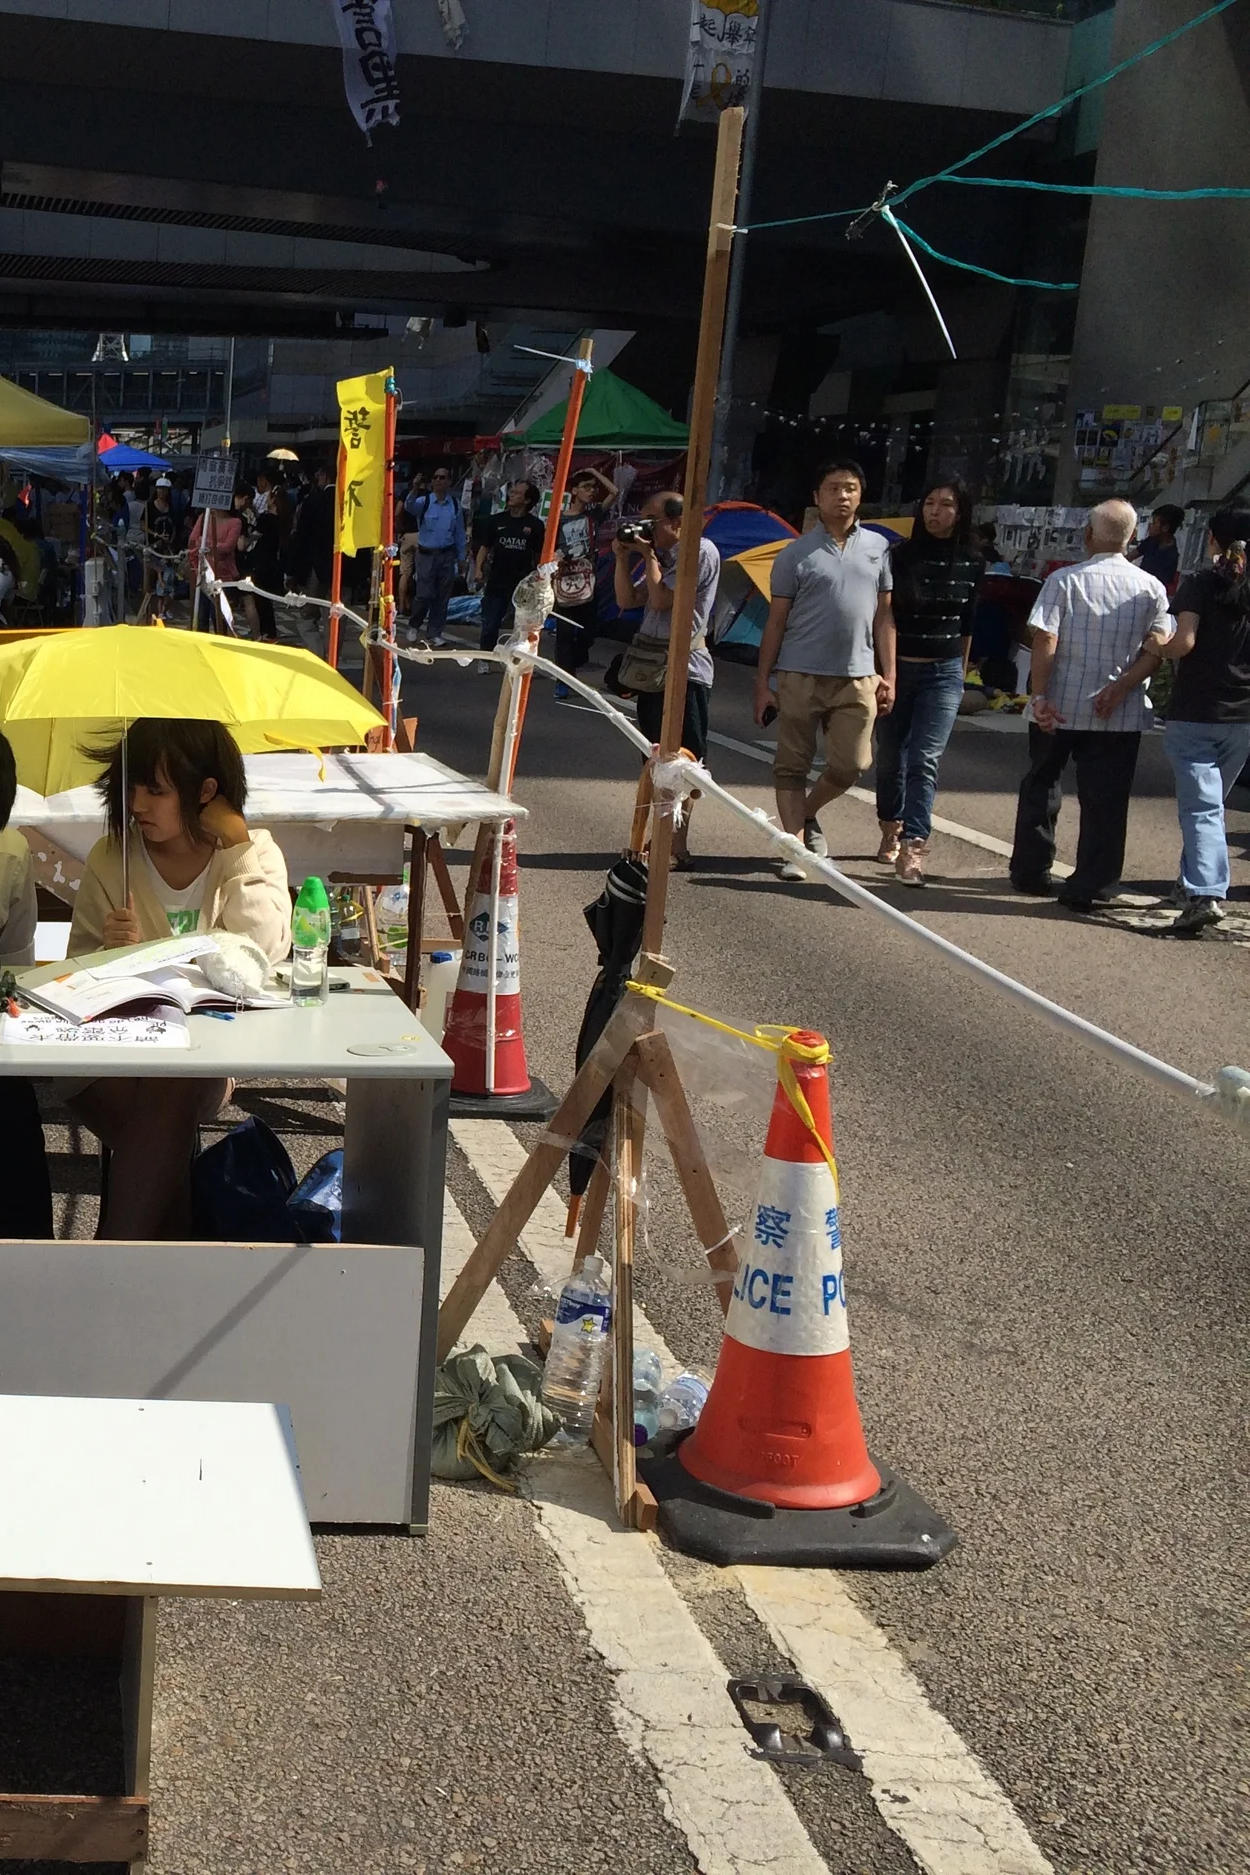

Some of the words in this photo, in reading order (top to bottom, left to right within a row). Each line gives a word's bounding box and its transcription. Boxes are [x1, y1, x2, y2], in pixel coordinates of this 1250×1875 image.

[499, 536, 527, 546] QATAR
[464, 949, 489, 964] CRB
[754, 1203, 792, 1249] 察
